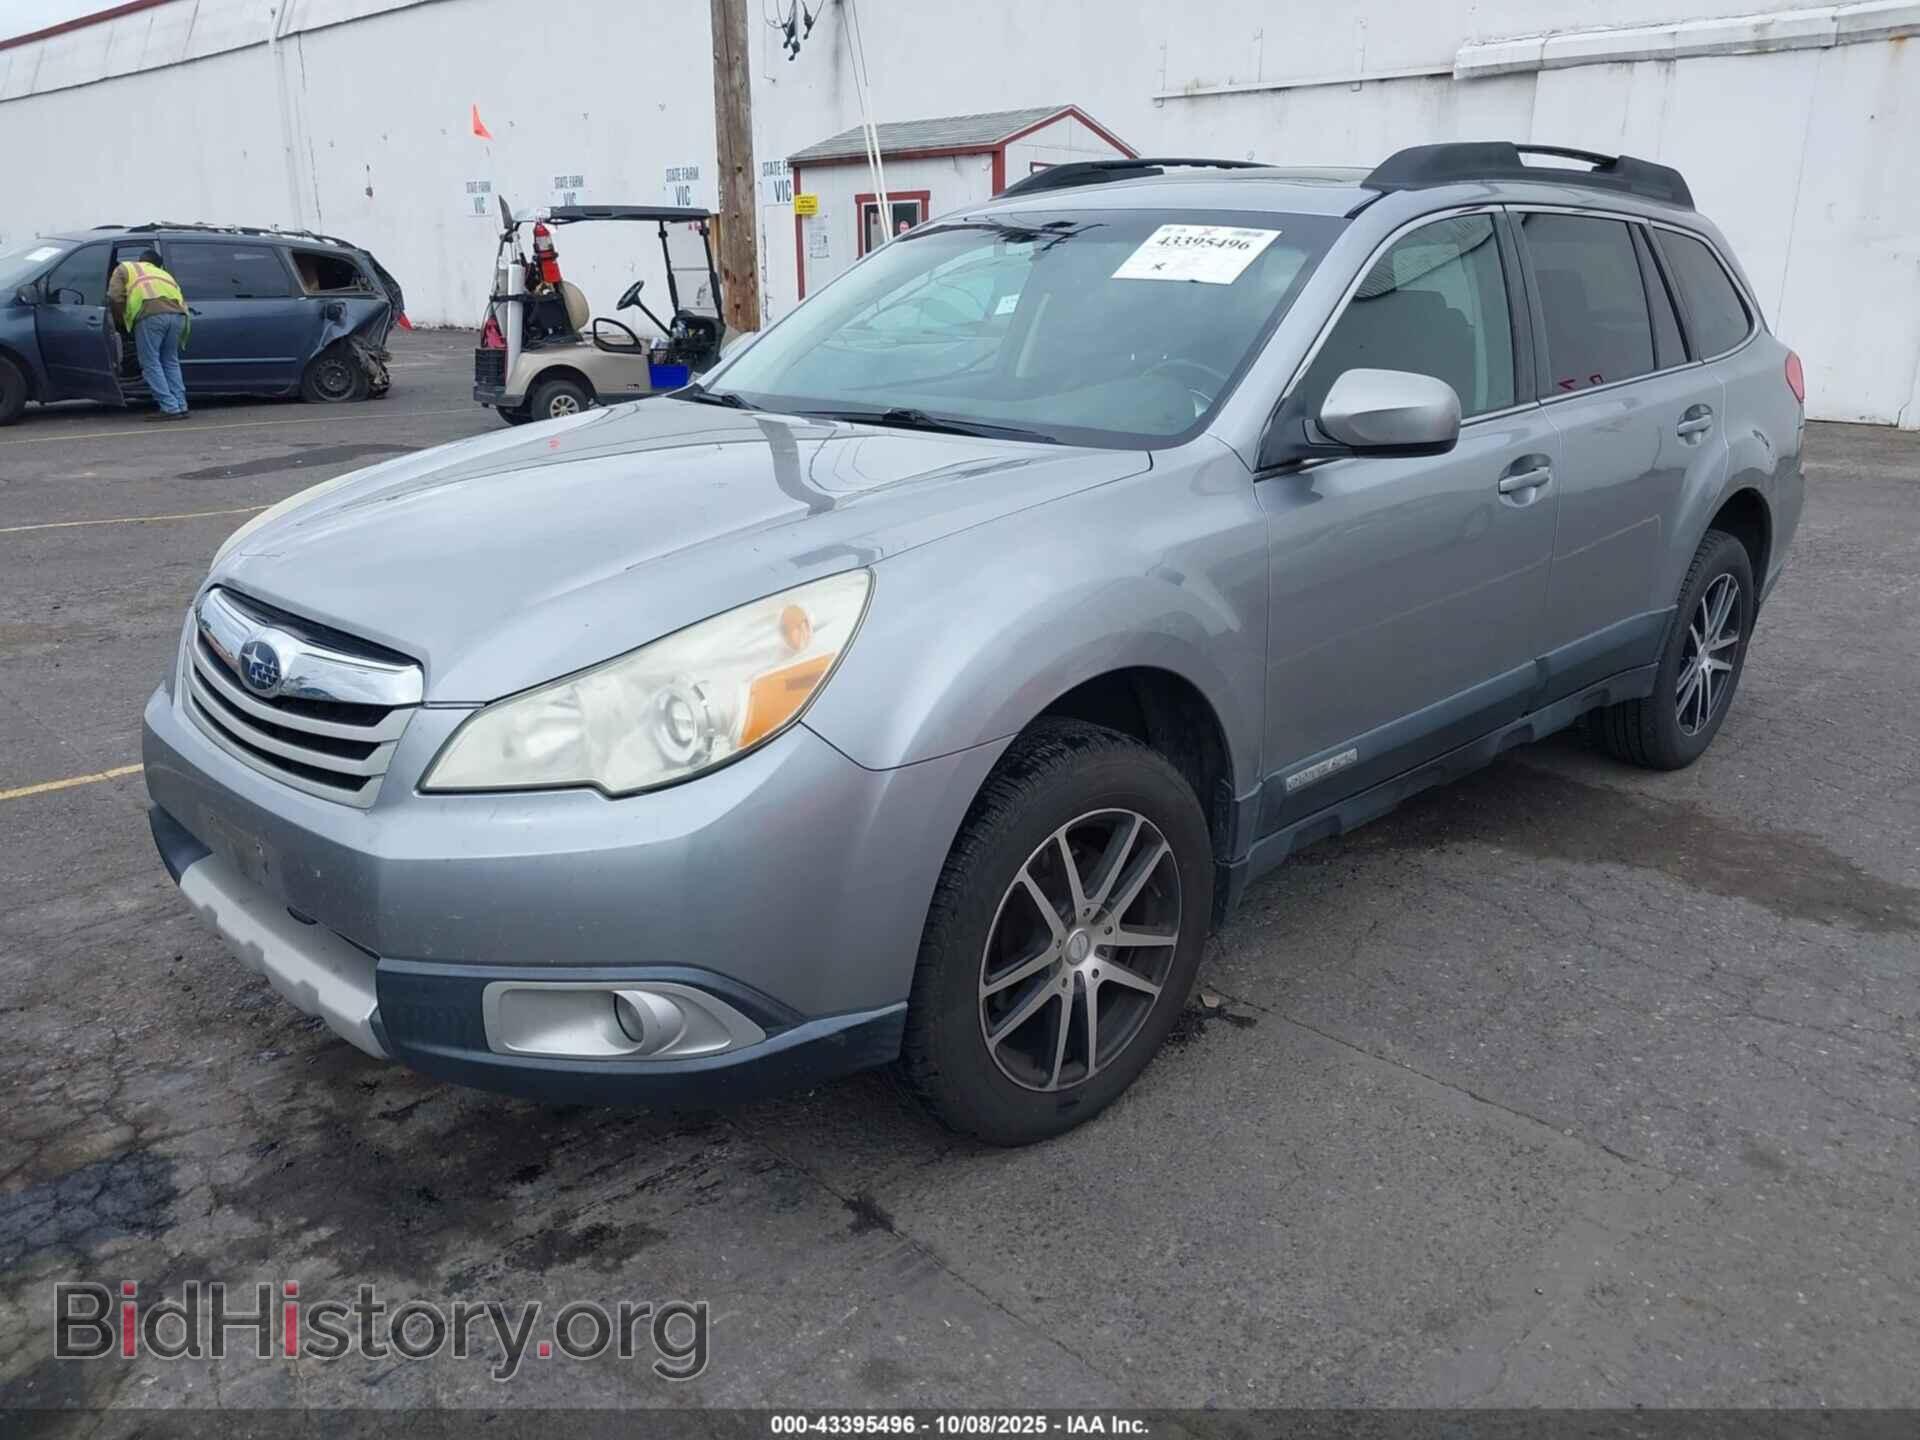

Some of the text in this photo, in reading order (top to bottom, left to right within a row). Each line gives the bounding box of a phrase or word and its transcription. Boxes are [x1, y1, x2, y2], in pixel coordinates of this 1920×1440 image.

[665, 168, 681, 183] STATE
[762, 160, 781, 177] STATE
[675, 185, 690, 206] VIC
[774, 179, 792, 203] VIC
[1157, 235, 1251, 251] 43395496
